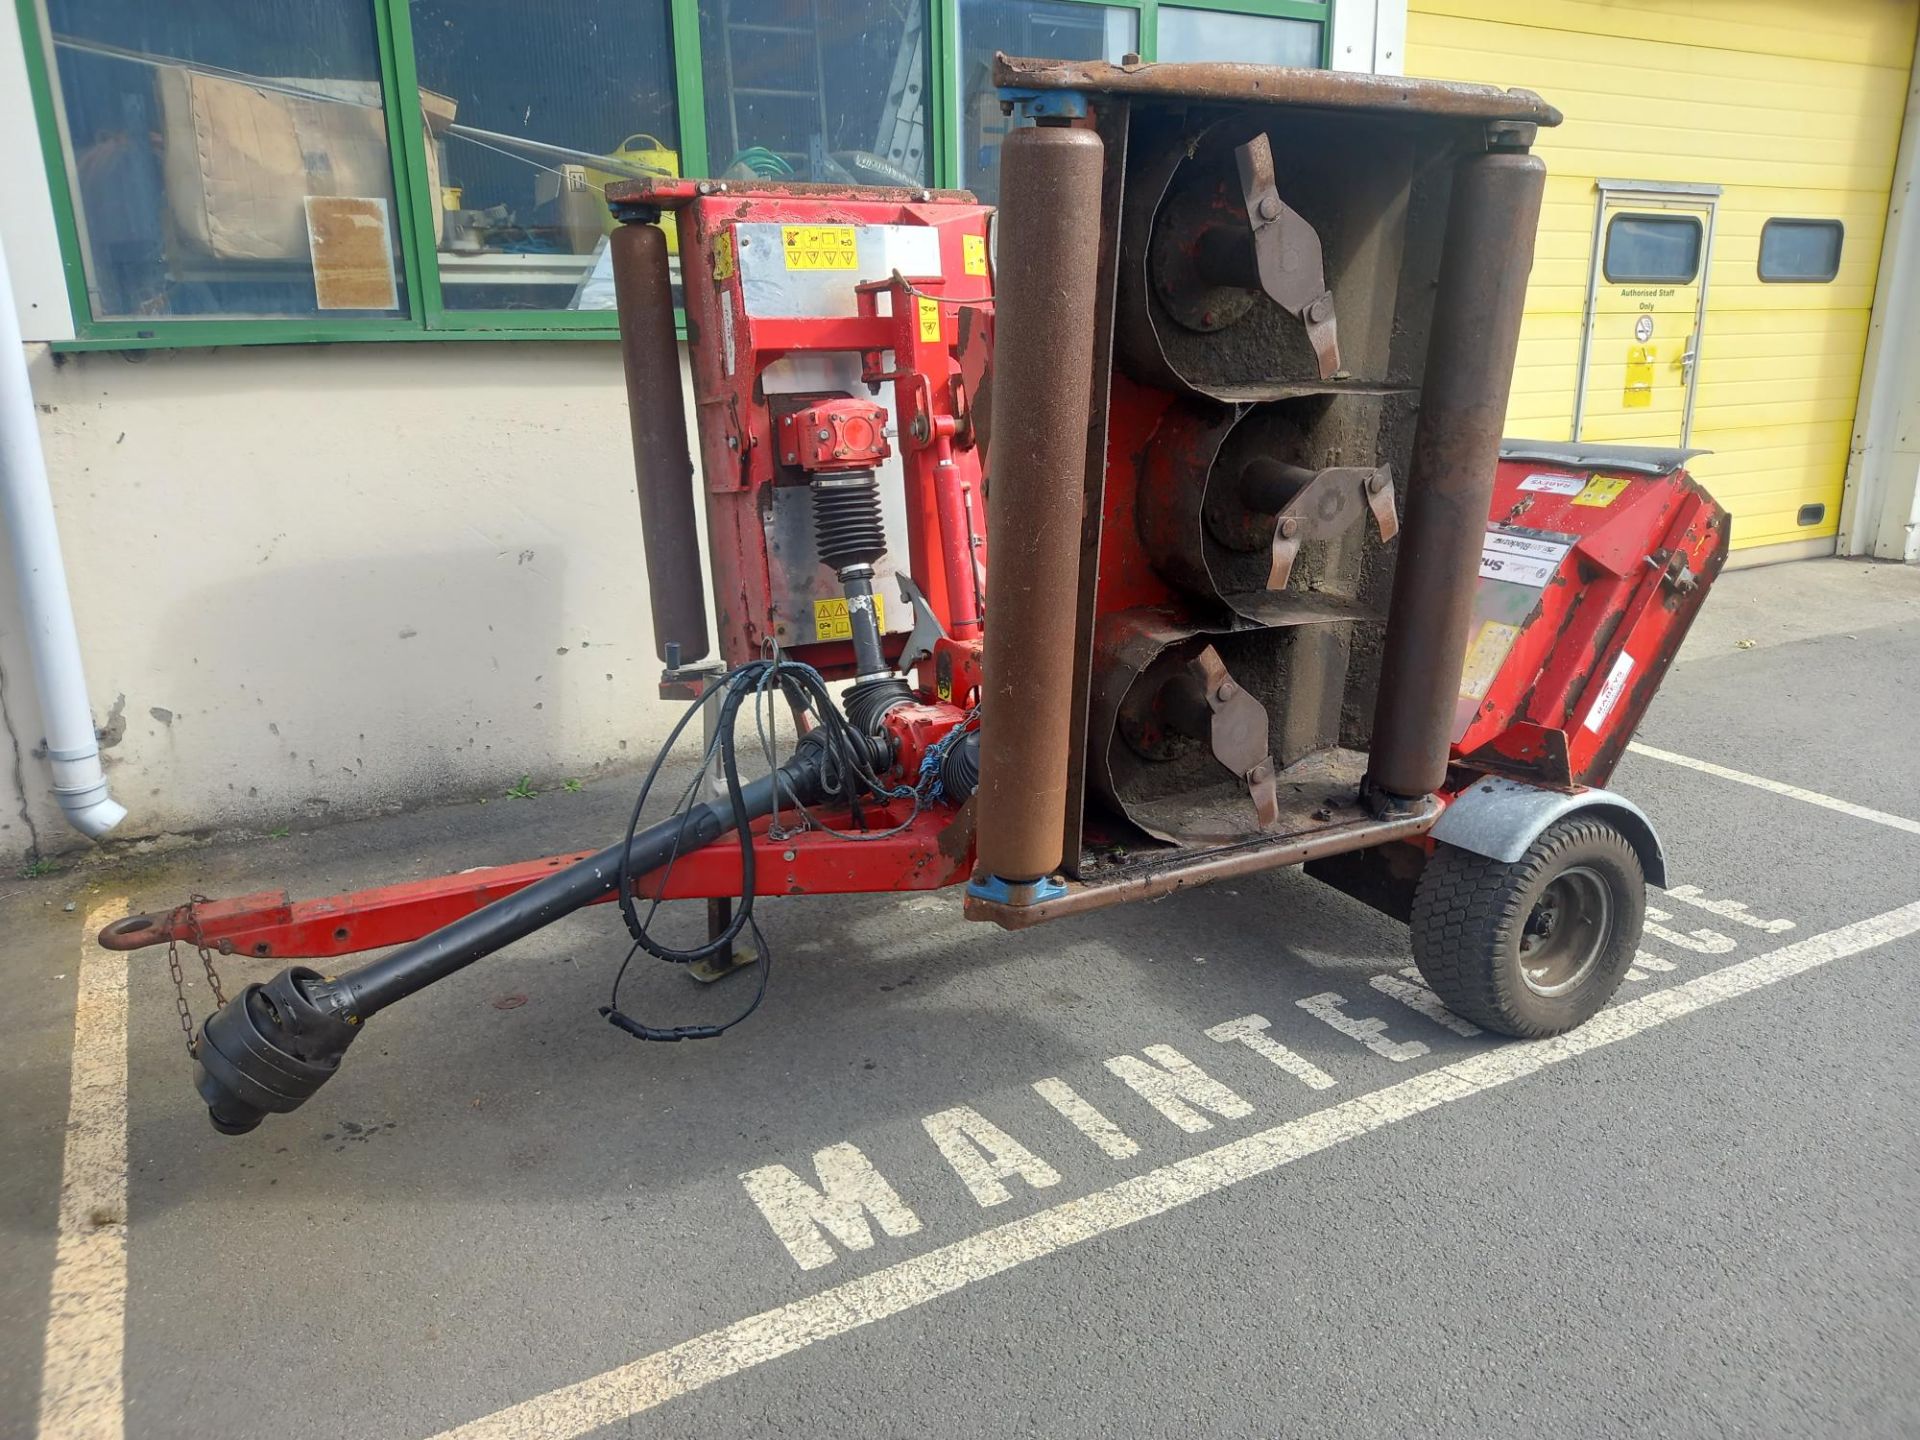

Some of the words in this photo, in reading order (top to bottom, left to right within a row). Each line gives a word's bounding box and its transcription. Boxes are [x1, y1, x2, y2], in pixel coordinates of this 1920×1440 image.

[1620, 288, 1657, 297] Authorised
[1659, 288, 1675, 297] Staff
[1639, 302, 1655, 311] Only
[737, 884, 1796, 1270] MAINTECE
